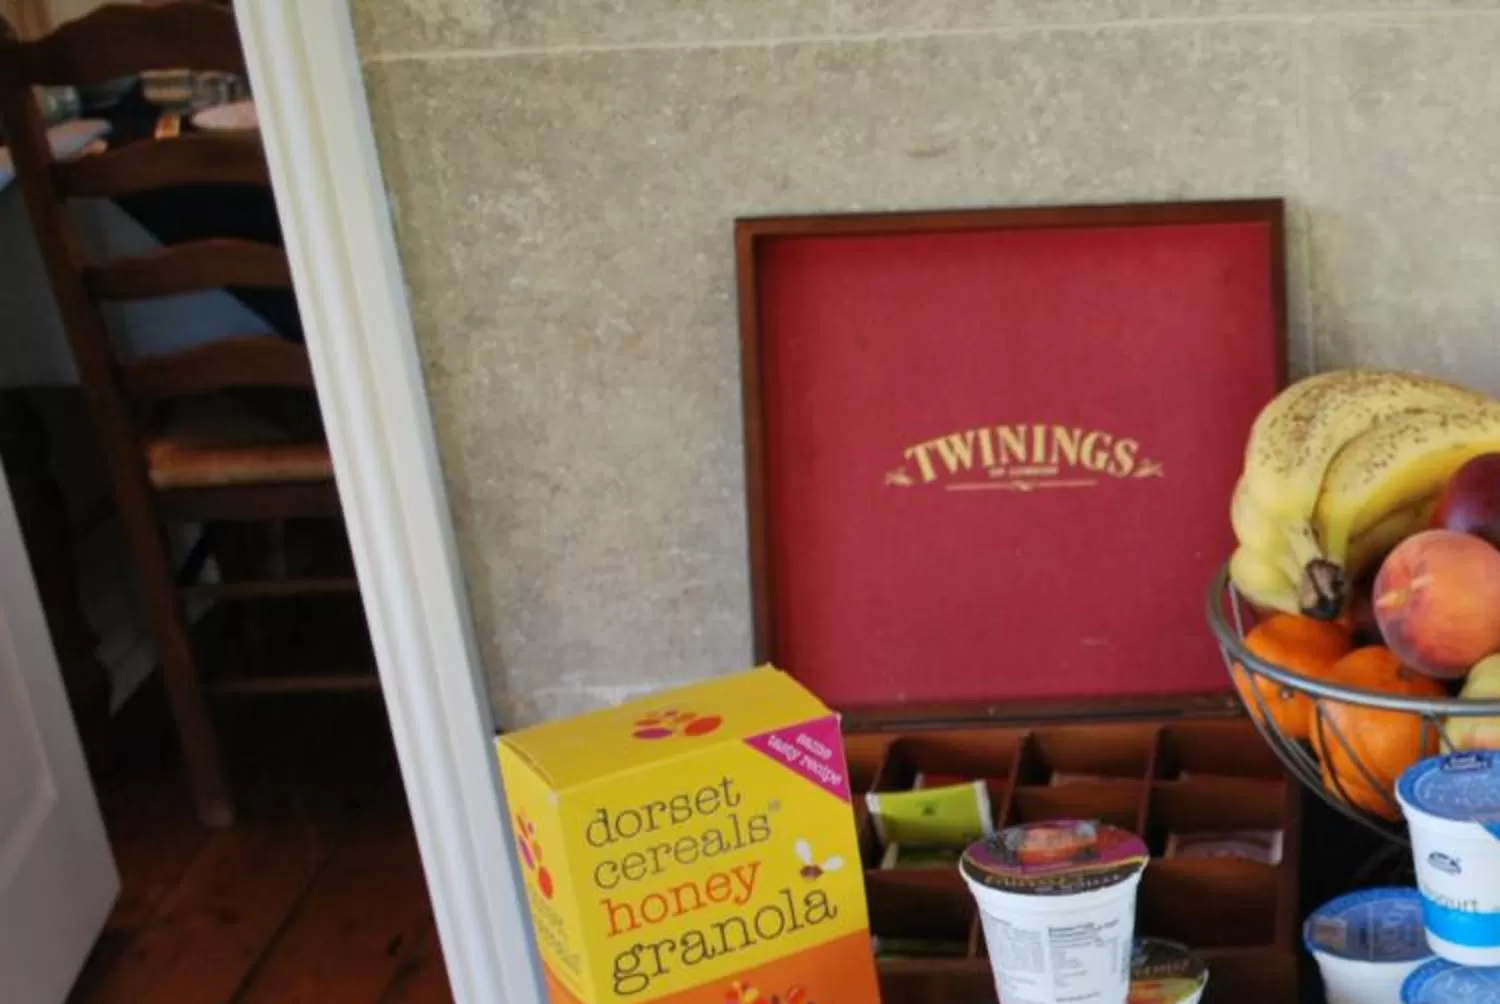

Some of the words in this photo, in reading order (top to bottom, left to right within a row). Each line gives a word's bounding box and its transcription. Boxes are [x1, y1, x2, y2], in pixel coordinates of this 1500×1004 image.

[903, 423, 1140, 483] TWININGS
[585, 776, 741, 848] dorset
[593, 813, 772, 890] cereals
[600, 860, 762, 938] honey
[612, 888, 838, 996] granola
